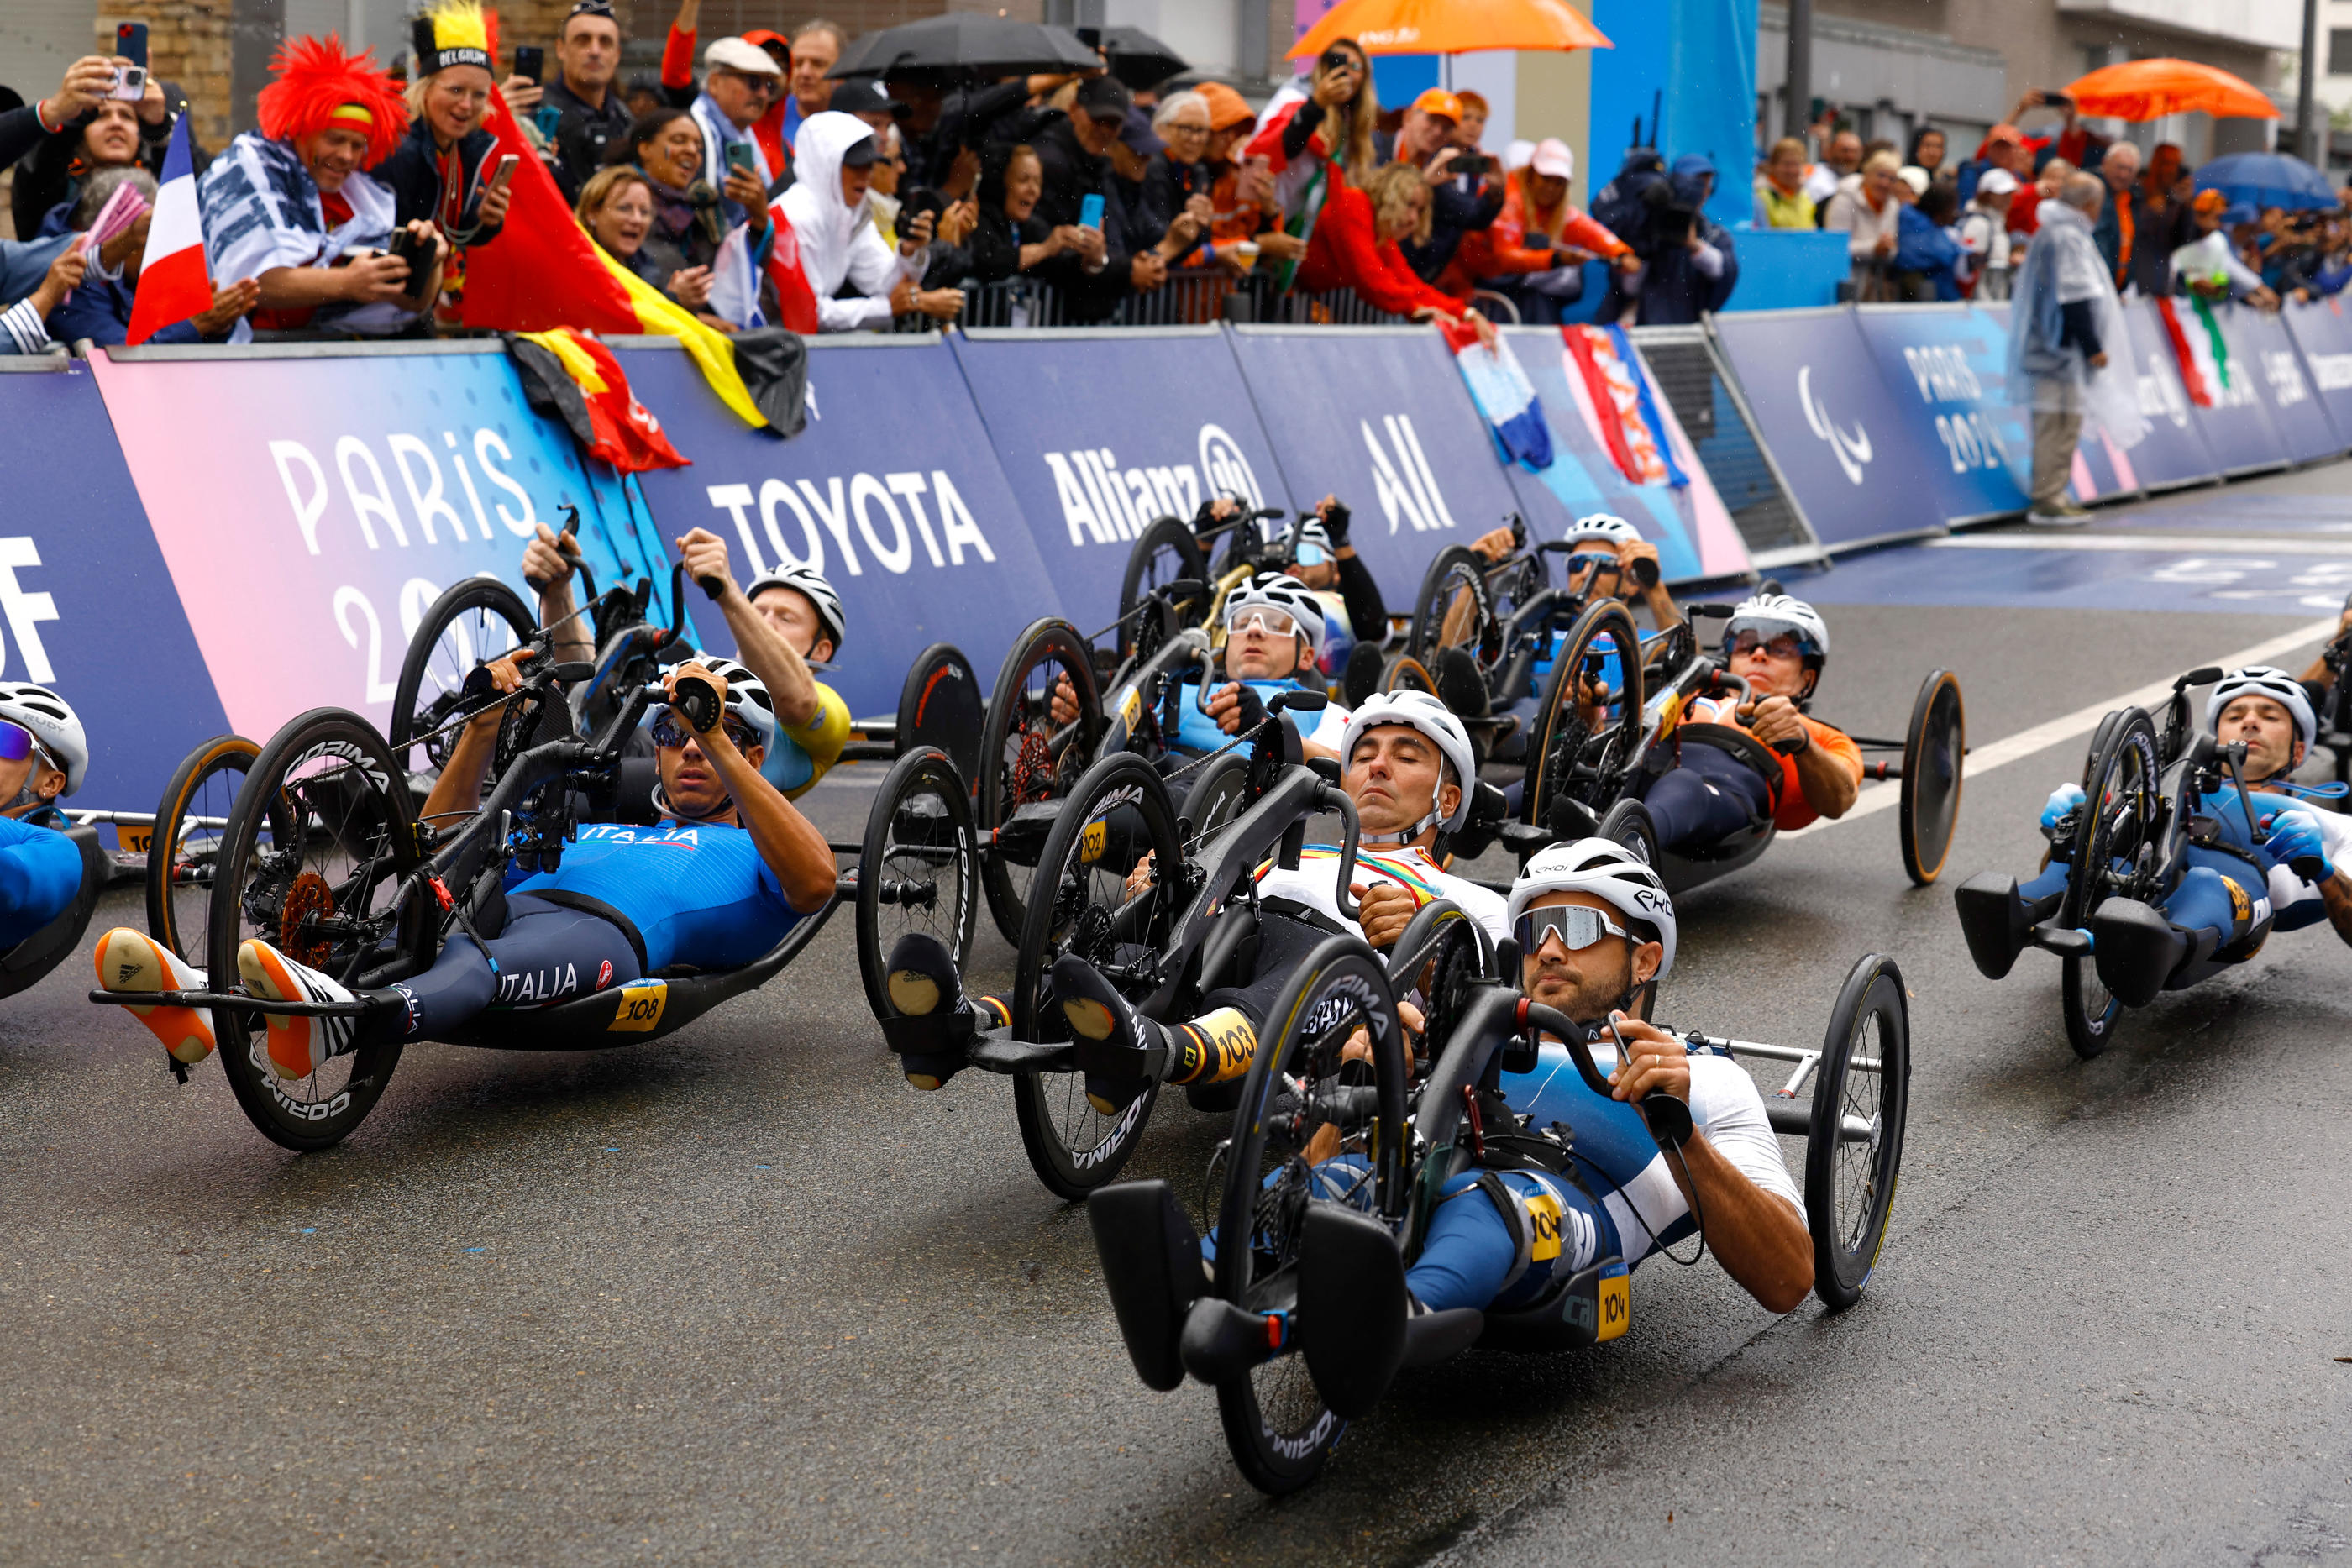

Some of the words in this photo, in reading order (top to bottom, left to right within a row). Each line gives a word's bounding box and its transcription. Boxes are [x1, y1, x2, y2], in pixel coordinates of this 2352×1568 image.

[439, 48, 486, 67] BELGIUM
[1044, 448, 1201, 547] Allianz
[706, 470, 996, 578] TOYOTA
[24, 713, 65, 734] RUDY
[281, 740, 390, 794] CORIMA
[581, 826, 699, 846] ITALIA
[953, 826, 969, 962] CORIMA
[626, 998, 659, 1021] 108
[1218, 1025, 1256, 1068] 103
[1530, 1210, 1562, 1243] 104
[1605, 1292, 1625, 1324] 104
